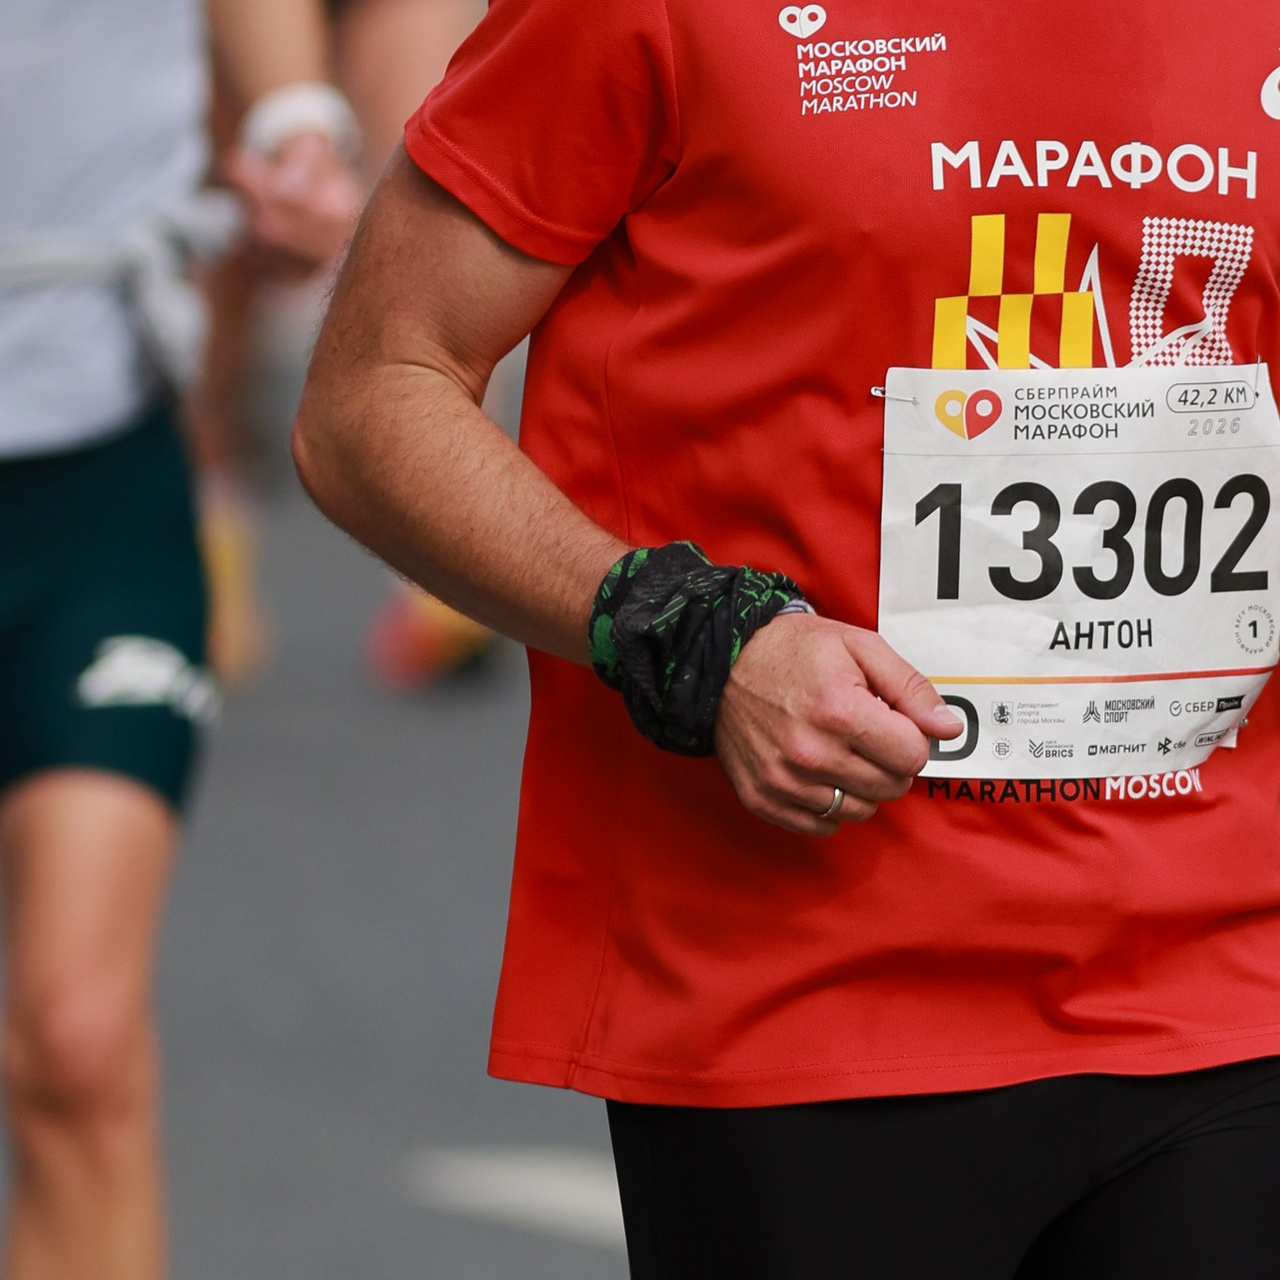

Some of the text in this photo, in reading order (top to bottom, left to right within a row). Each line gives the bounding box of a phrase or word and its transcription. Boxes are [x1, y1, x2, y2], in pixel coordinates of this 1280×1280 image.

[796, 33, 947, 60] МОСКОВСКИЙ
[798, 55, 907, 78] МАРАФОН
[800, 74, 894, 97] MOSCOW
[801, 91, 917, 115] MARATHON
[930, 140, 1257, 200] МАРАФОН
[1014, 384, 1118, 400] СБЕРПРАЙМ
[1177, 388, 1218, 408] 42,2
[1014, 399, 1155, 421] МОСКОВСКИЙ
[1014, 423, 1118, 440] МАРАФОН
[1187, 416, 1242, 436] 2026
[914, 473, 1271, 601] 13302
[1048, 618, 1153, 651] АНТОН
[1247, 619, 1258, 639] 1
[1103, 696, 1156, 711] МОСКОВСКИЙ
[1184, 701, 1215, 714] СБЕР
[1103, 711, 1129, 723] СПОРТ
[1045, 749, 1074, 758] BRICS
[1099, 743, 1147, 755] магнит
[927, 778, 1101, 803] MARATHON
